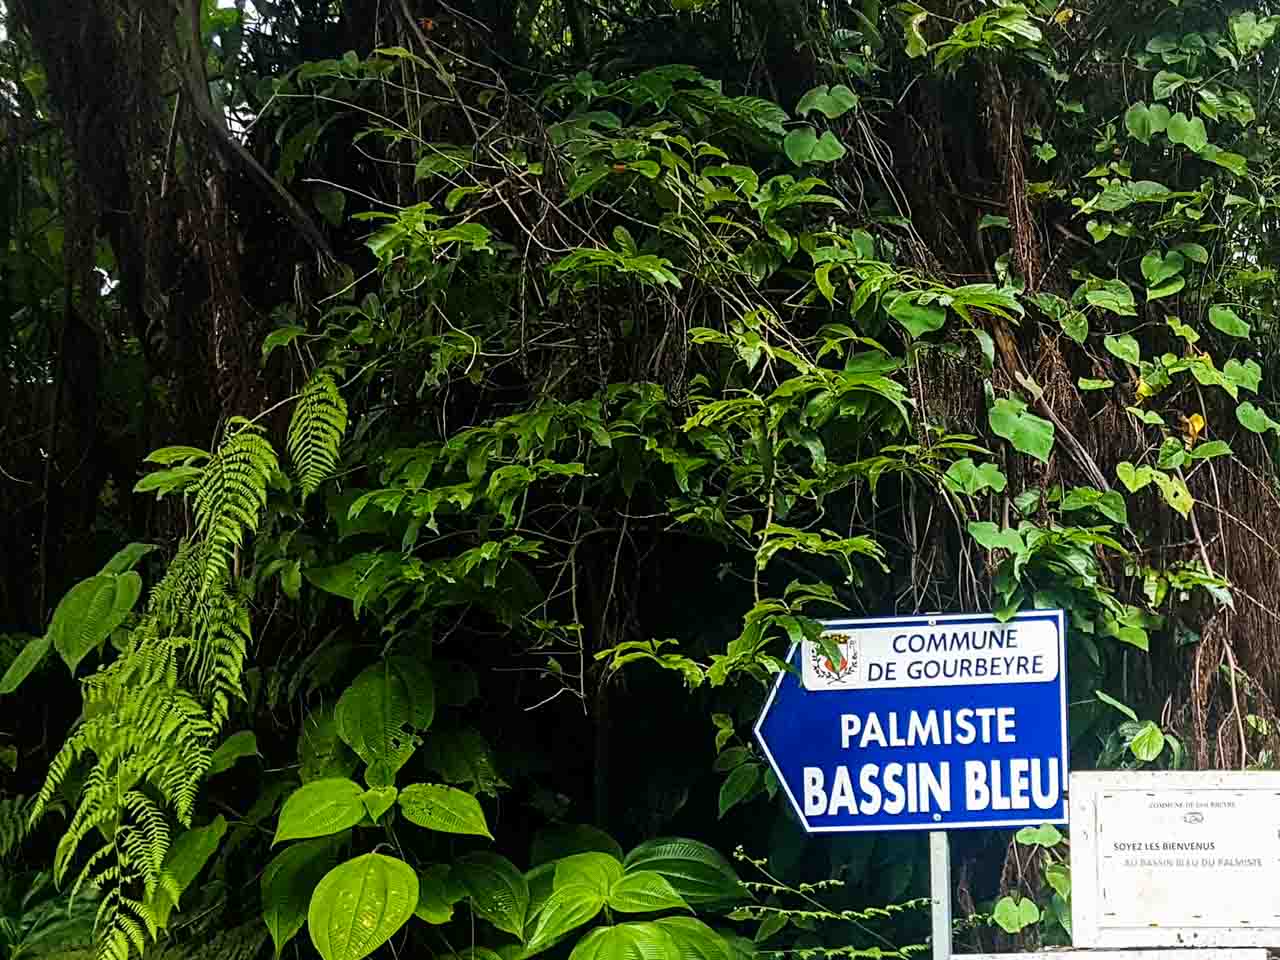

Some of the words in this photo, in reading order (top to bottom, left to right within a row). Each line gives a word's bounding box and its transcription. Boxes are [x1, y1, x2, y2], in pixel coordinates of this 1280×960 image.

[892, 629, 1019, 654] COMMUNE
[868, 662, 896, 681] DE
[907, 655, 1044, 680] GOURBEYRE
[840, 706, 1017, 749] PALMISTE
[803, 760, 951, 816] BASSIN
[964, 757, 1059, 811] BLEU
[1113, 842, 1143, 851] SOYEZ
[1144, 842, 1161, 851] LES
[1162, 841, 1216, 851] BIENVENUS
[1201, 858, 1216, 867] DU
